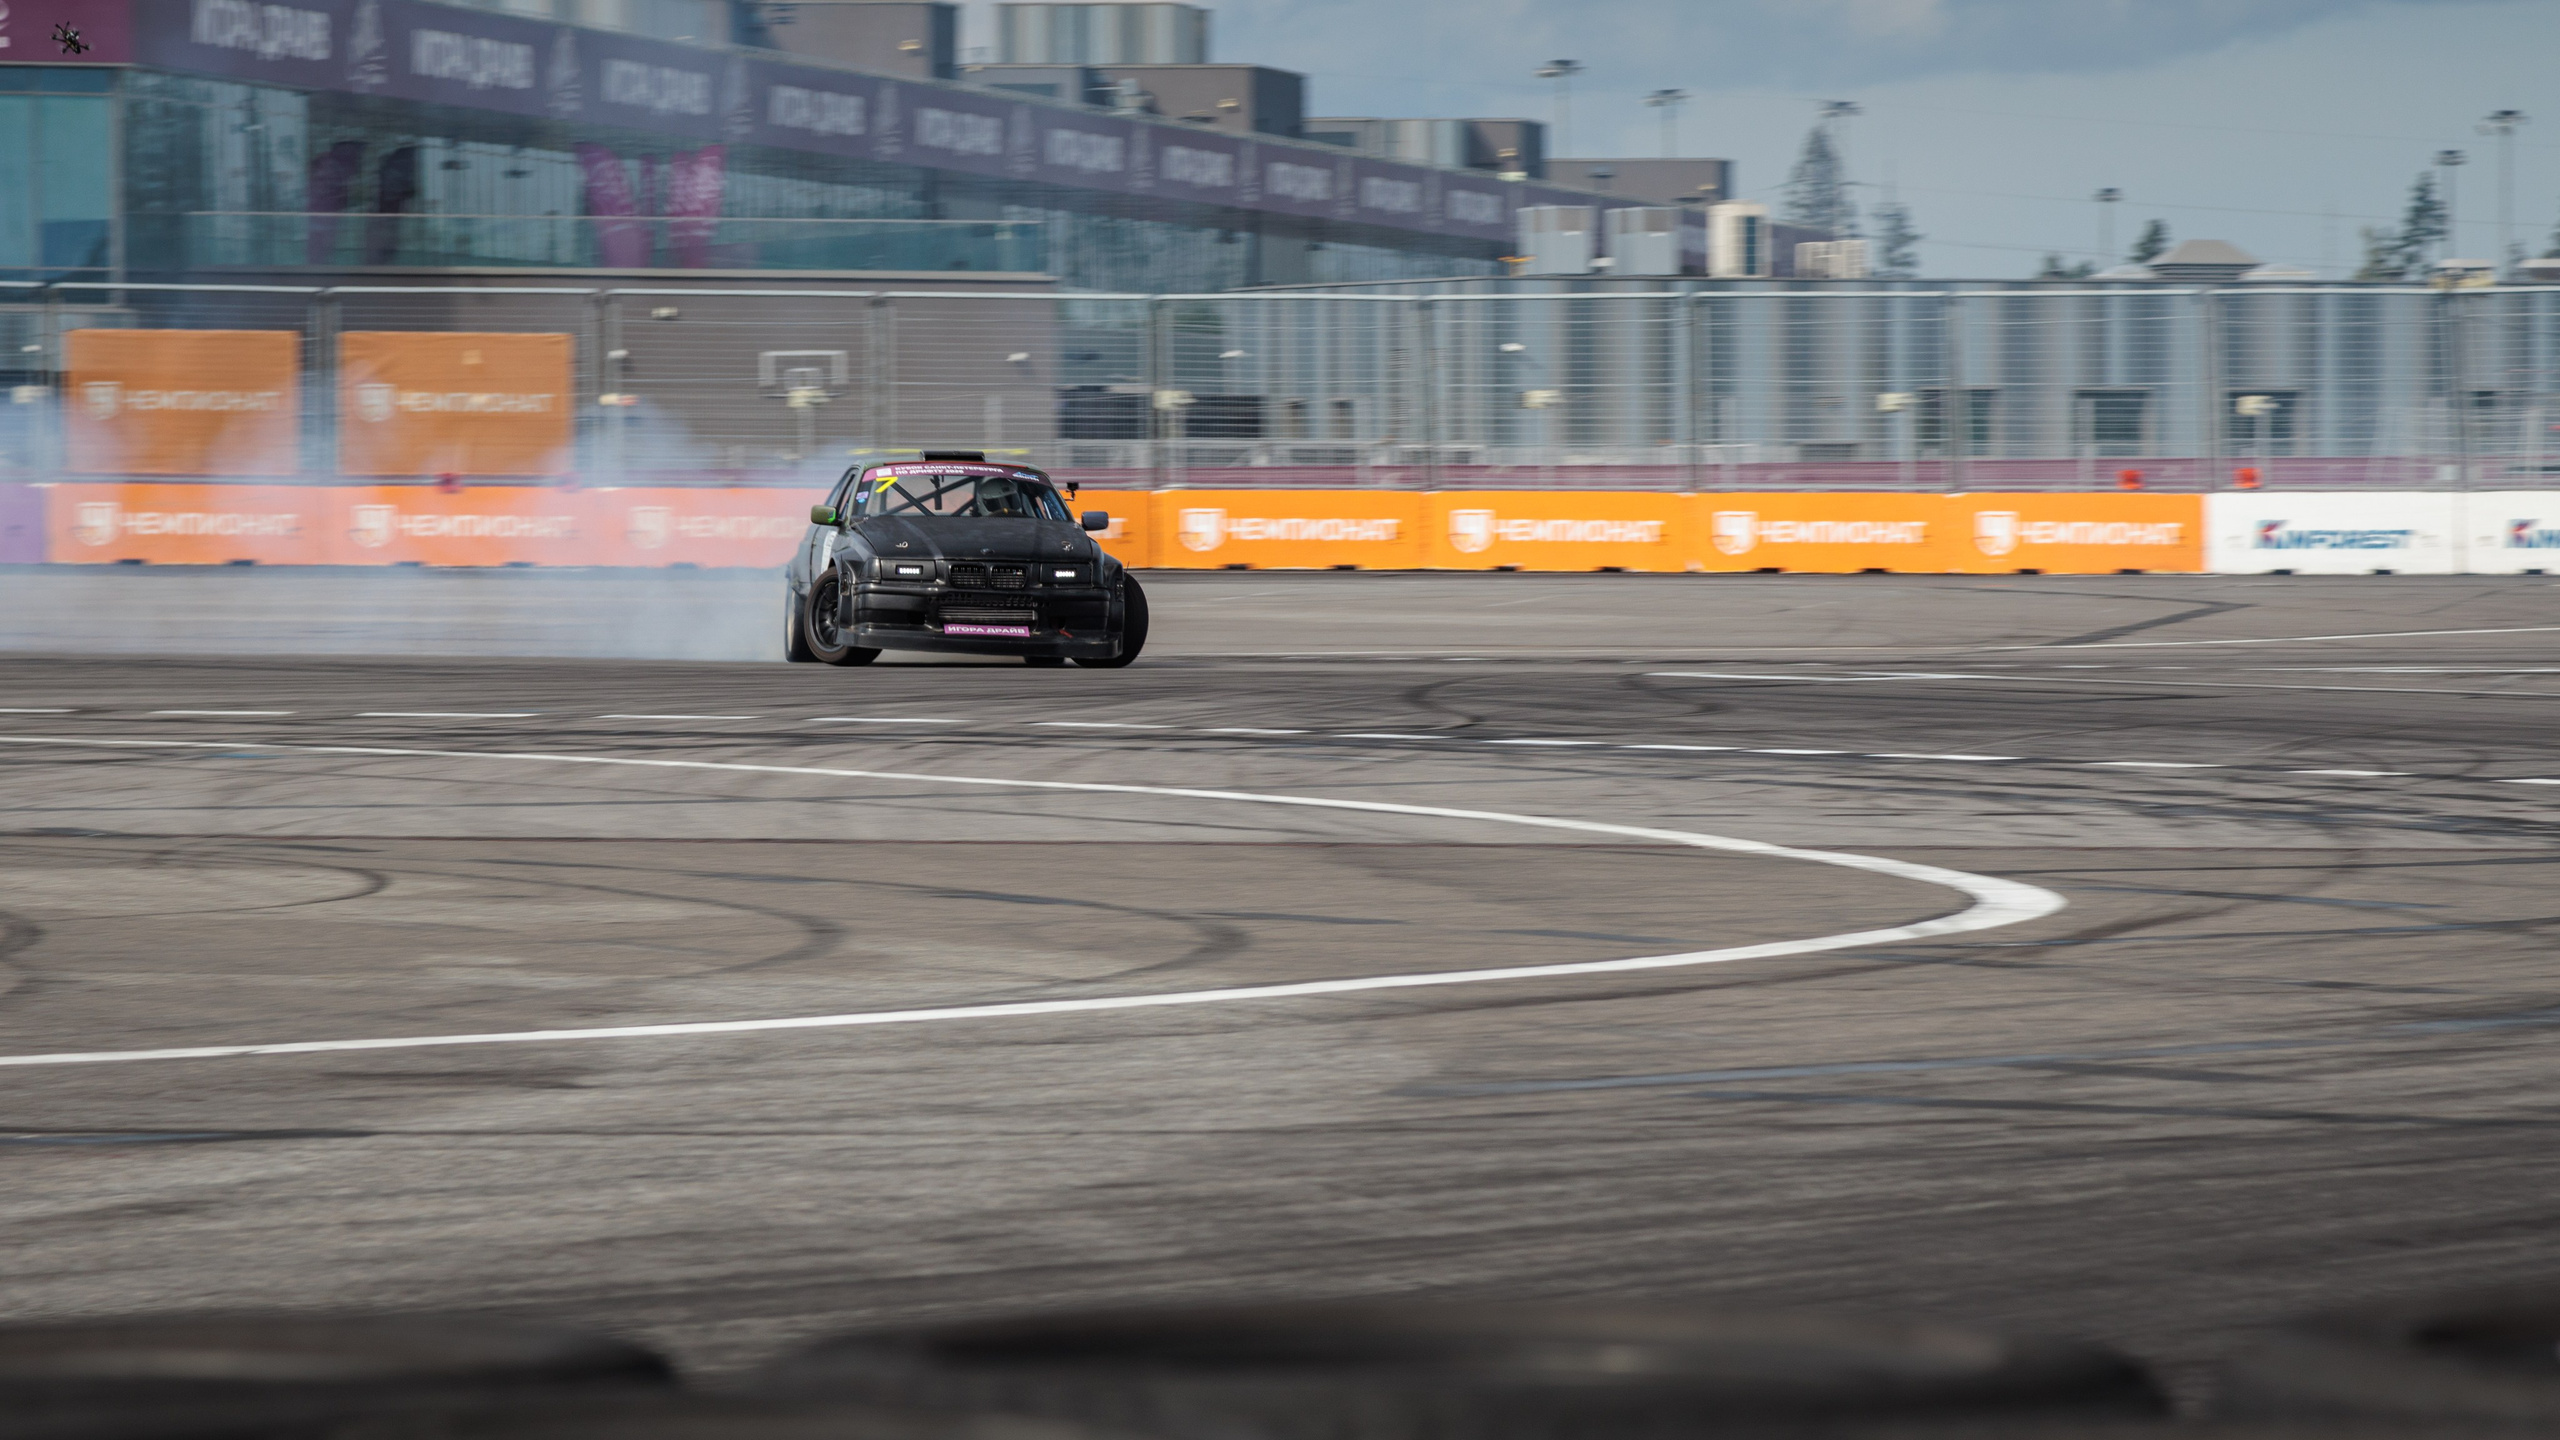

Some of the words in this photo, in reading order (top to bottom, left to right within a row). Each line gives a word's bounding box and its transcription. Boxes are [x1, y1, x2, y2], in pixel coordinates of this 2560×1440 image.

[875, 476, 898, 493] 7
[1226, 518, 1402, 540] ЧЕМПИОНАТ
[1495, 519, 1665, 543] ЧЕМПИОНАТ
[1752, 520, 1927, 544] ЧЕМПИОНАТ
[2016, 521, 2185, 546] ЧЕМПИОНАТ
[948, 625, 984, 633] ИГОРА
[986, 626, 1026, 635] ДРАЙВ
